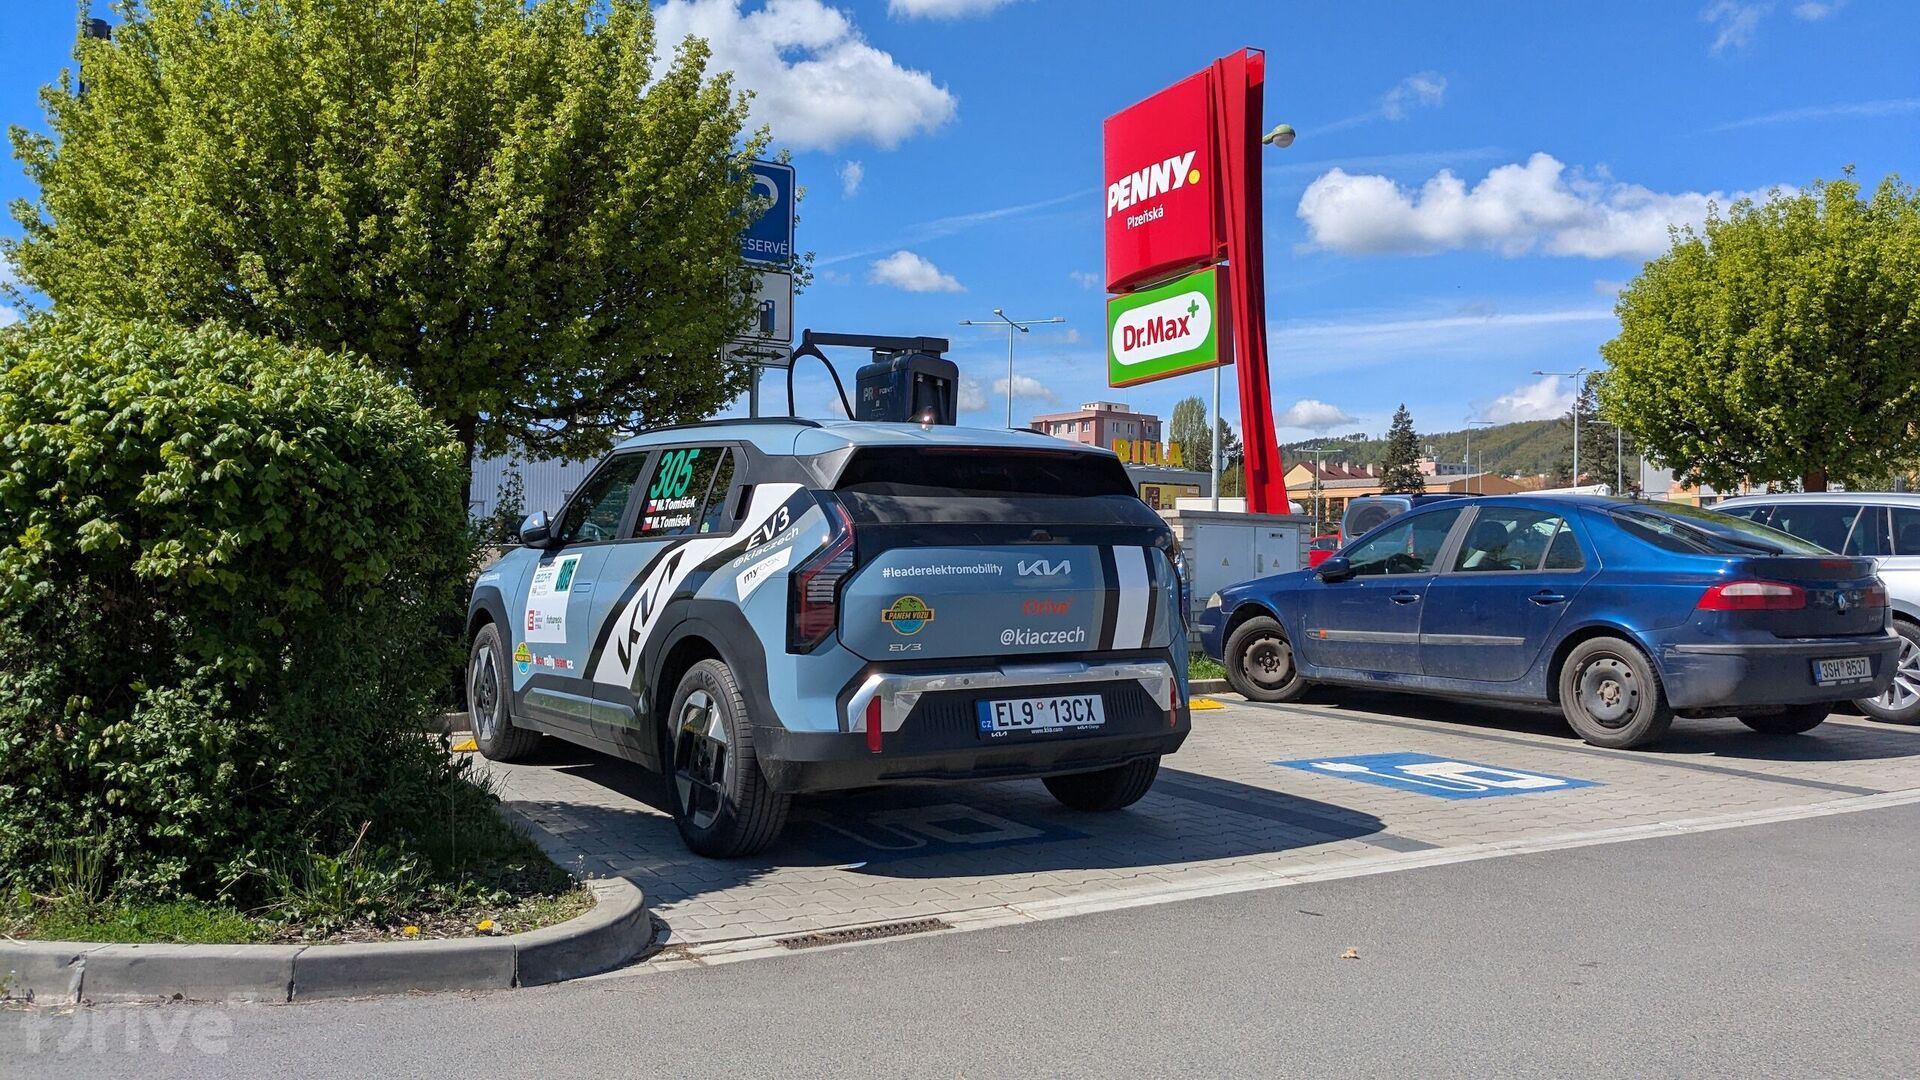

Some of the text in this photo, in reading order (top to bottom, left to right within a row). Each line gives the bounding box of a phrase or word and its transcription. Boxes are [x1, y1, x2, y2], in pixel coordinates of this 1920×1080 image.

[1127, 204, 1164, 229] Plzeňská
[1112, 438, 1184, 467] BILLA
[651, 449, 700, 499] 305
[656, 496, 697, 511] M.Tomíšek
[651, 514, 692, 529] M.Tomíšek
[745, 506, 790, 551] EV3
[733, 527, 800, 568] @kiaczech
[882, 564, 1003, 578] #leaderelektromobility
[1017, 559, 1071, 576] KIA
[1000, 626, 1085, 645] @kiaczech
[889, 643, 922, 651] EV3
[1822, 661, 1840, 678] 3SH
[1845, 659, 1866, 676] 8537
[995, 698, 1096, 727] EL9 13CX
[981, 720, 992, 728] CZ
